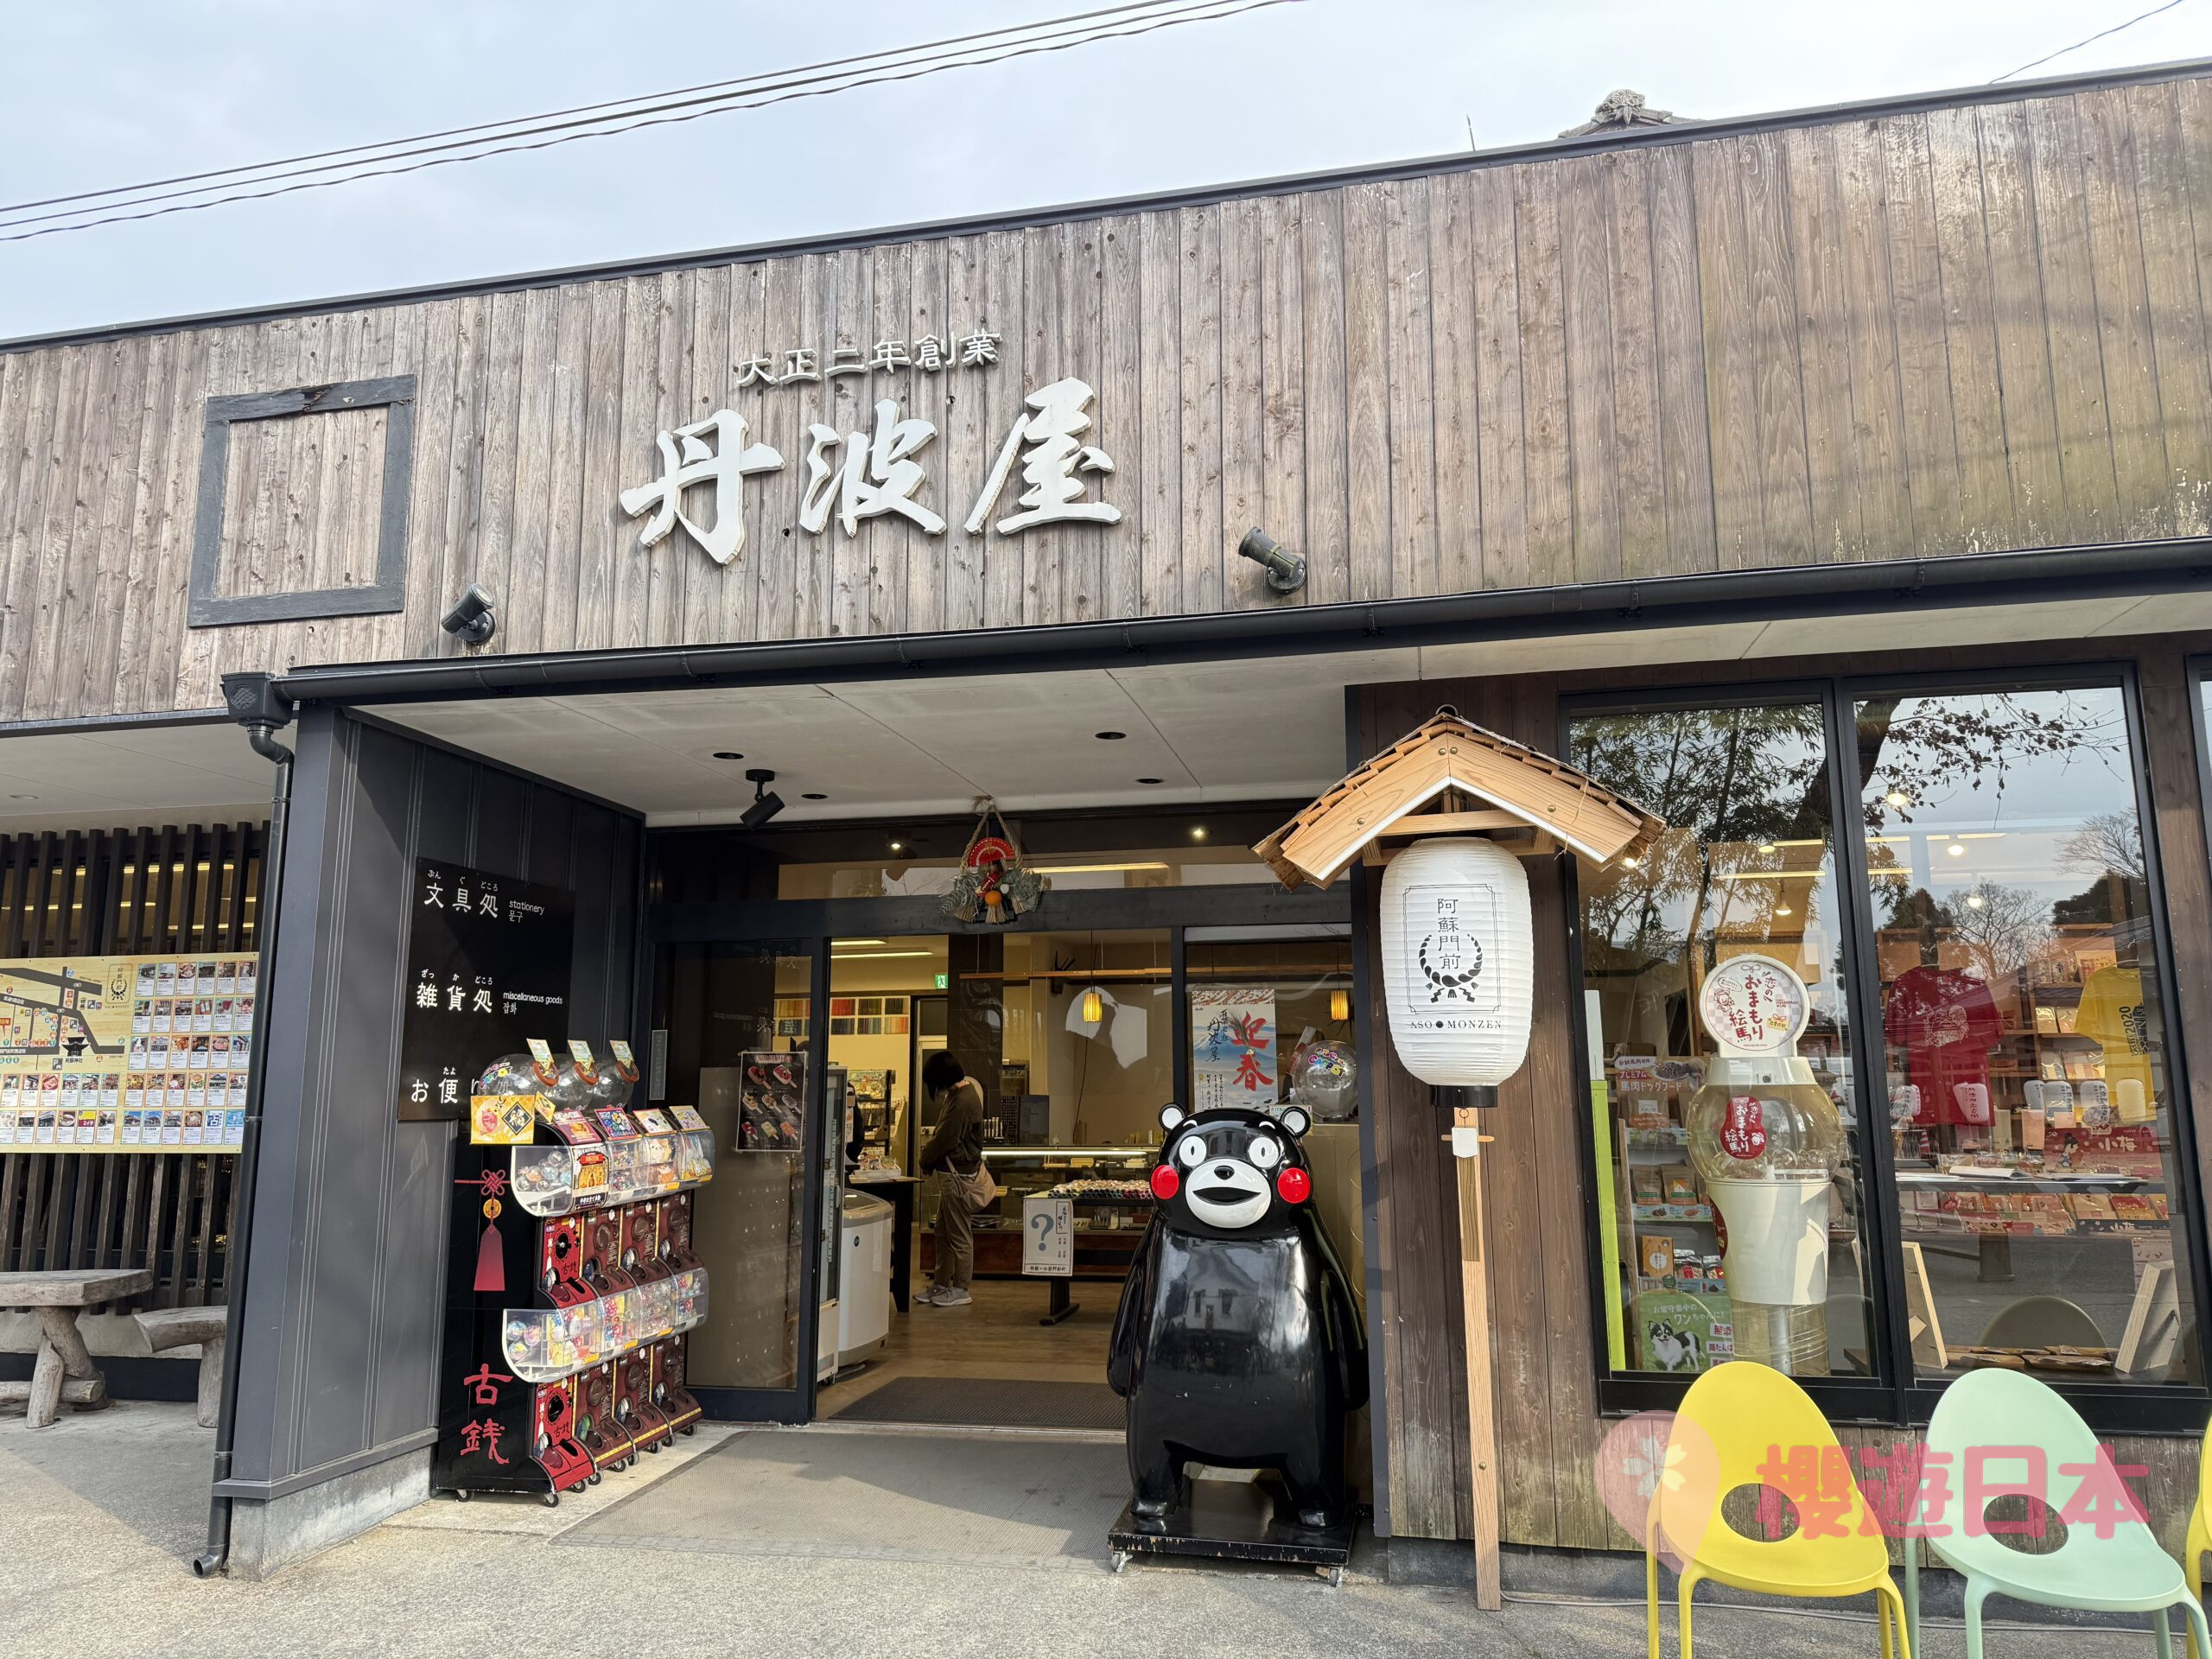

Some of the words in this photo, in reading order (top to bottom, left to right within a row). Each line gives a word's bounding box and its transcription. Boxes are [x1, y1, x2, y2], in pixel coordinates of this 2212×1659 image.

[735, 329, 1002, 388] 大正二年創業
[620, 377, 1122, 565] 丹波屋
[423, 882, 499, 918] 文具処
[480, 880, 499, 892] どころ
[508, 899, 545, 915] stationery
[1438, 899, 1460, 969] 阿蘇門前
[474, 975, 493, 985] どころ
[416, 982, 493, 1014] 雑貨処
[503, 991, 543, 1003] miscellaneous
[545, 995, 563, 1005] goods
[1745, 974, 1764, 1040] おまもり
[1410, 1020, 1433, 1029] ASO
[1447, 1020, 1502, 1030] MONZEN
[1728, 1008, 1752, 1043] 絵馬
[2119, 1006, 2137, 1034] 2020
[1205, 1016, 1223, 1063] 丹波屋
[1230, 1011, 1274, 1092] 迎春
[1619, 1071, 1647, 1079] プレミアム
[1725, 1128, 1741, 1154] 絵馬
[1736, 1104, 1750, 1153] おまもり
[2098, 1135, 2138, 1153] 小梅
[460, 1363, 514, 1466] 古銭
